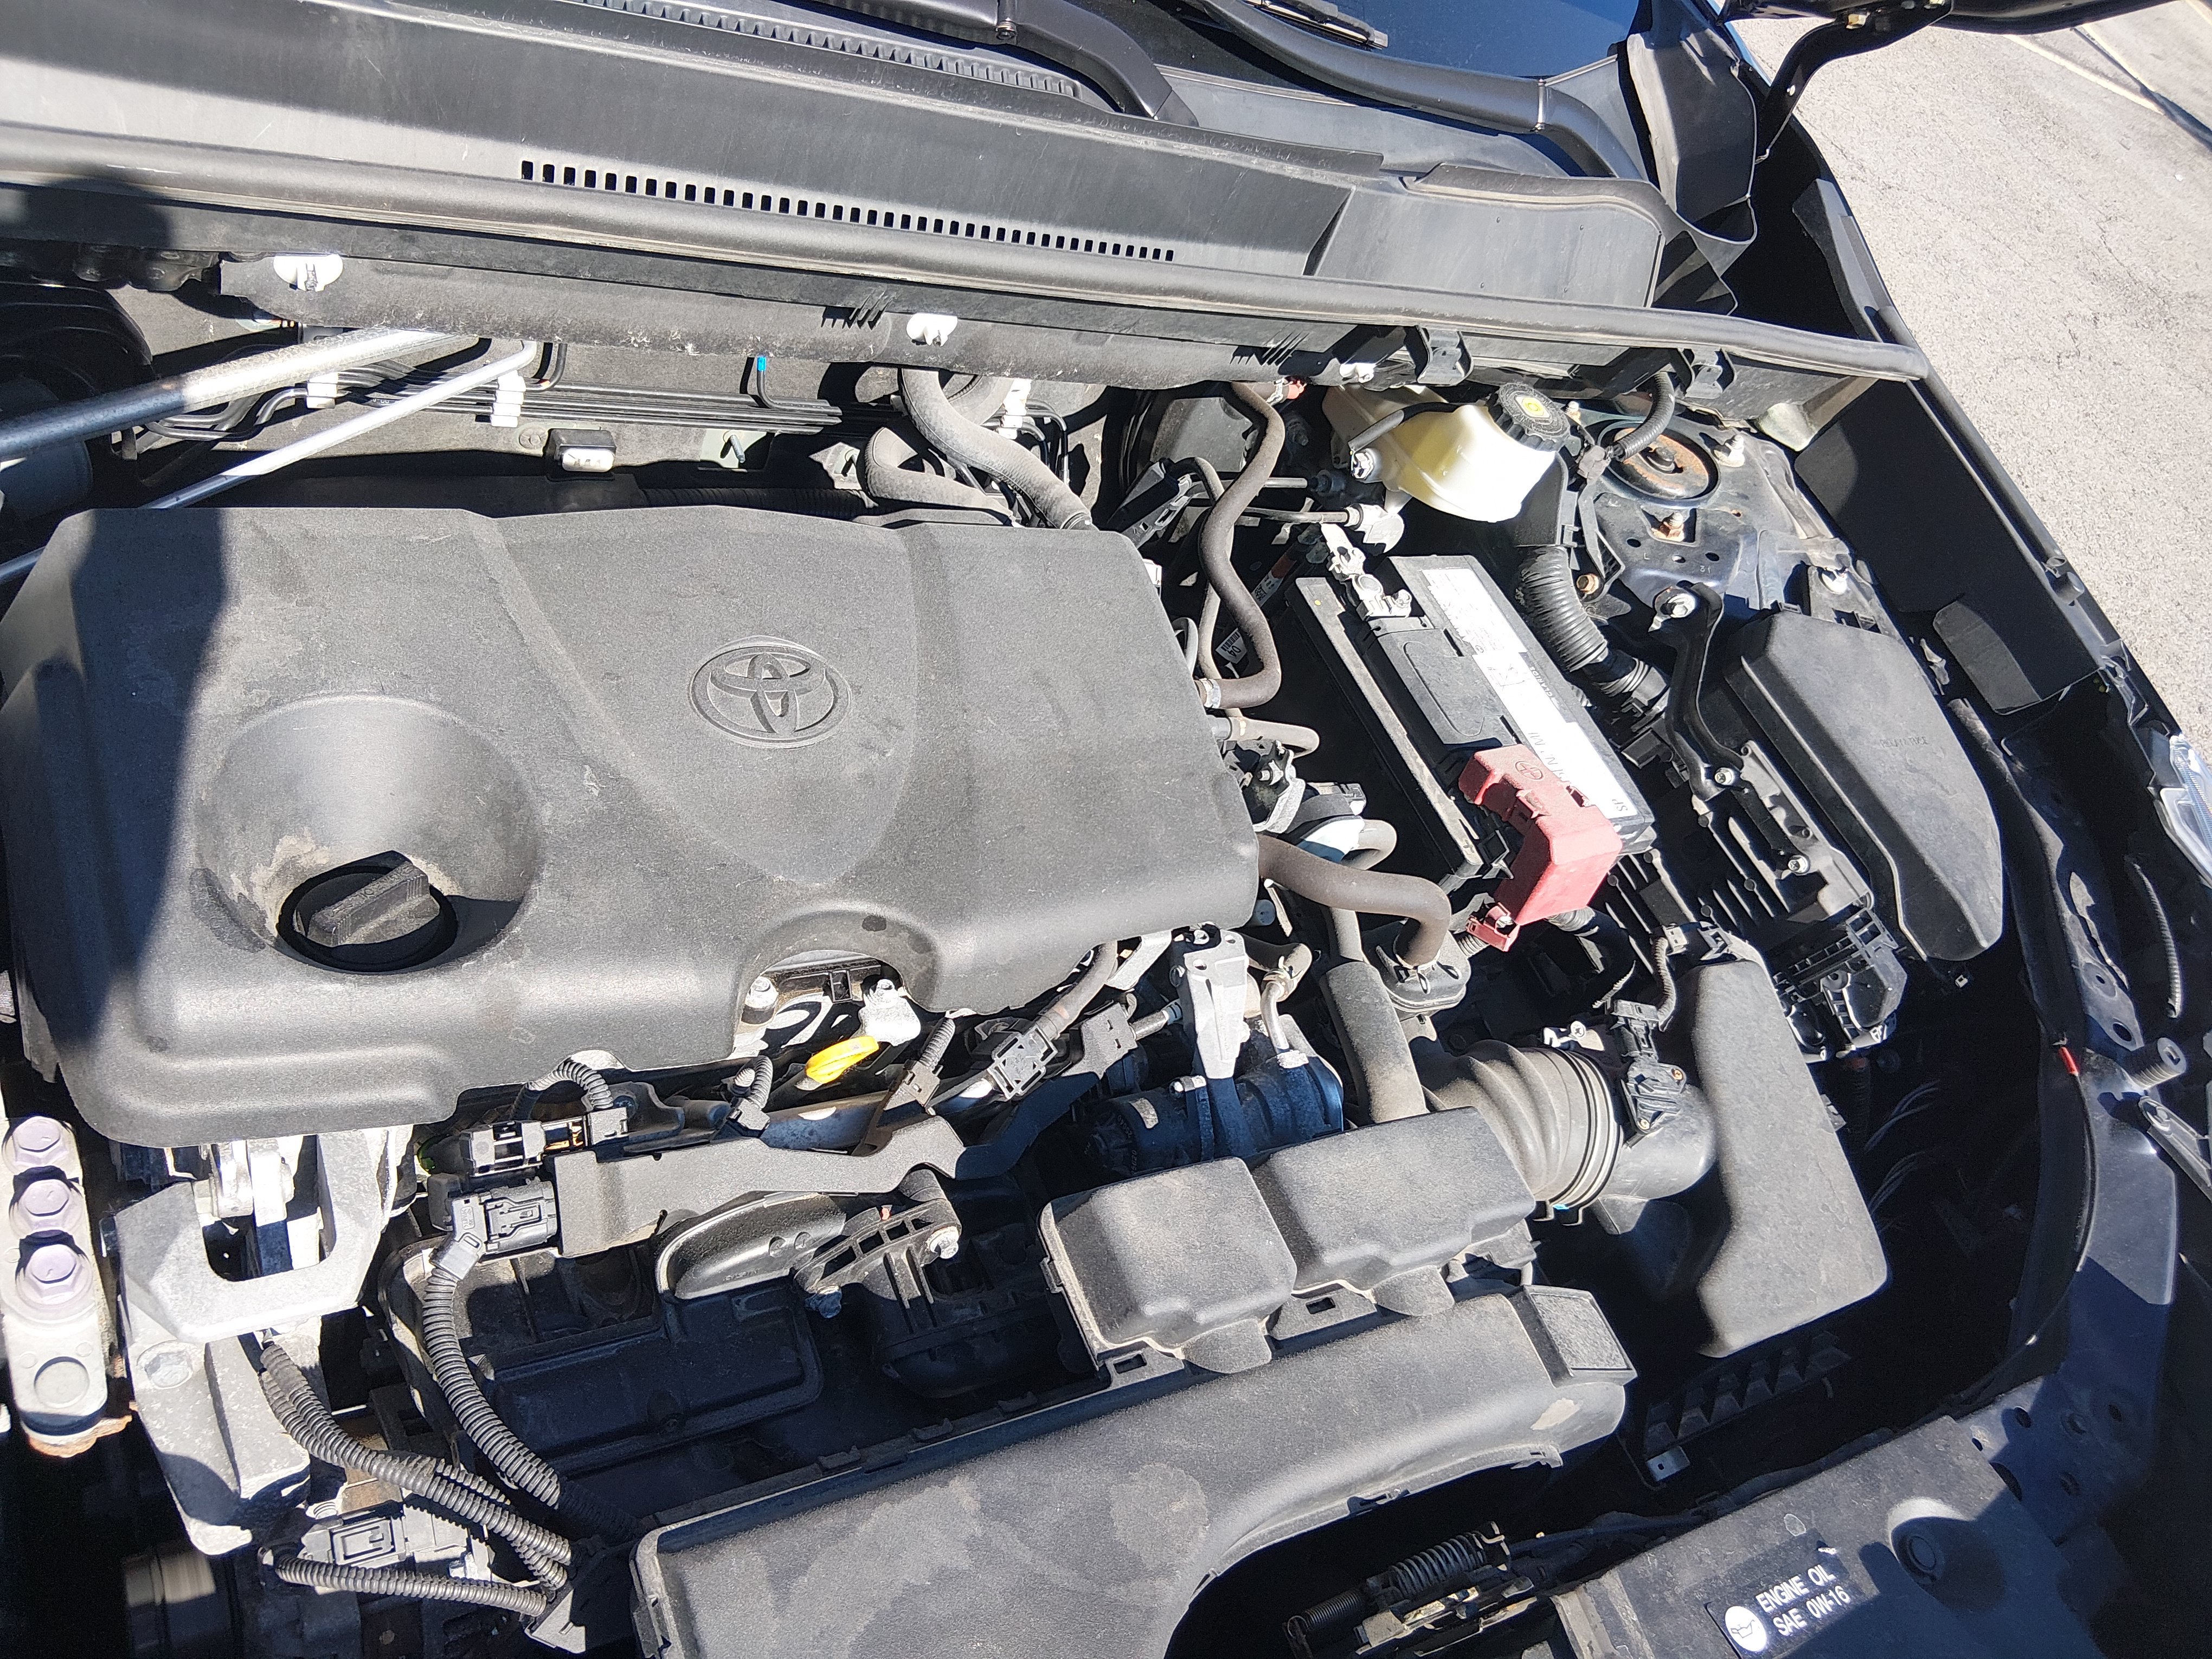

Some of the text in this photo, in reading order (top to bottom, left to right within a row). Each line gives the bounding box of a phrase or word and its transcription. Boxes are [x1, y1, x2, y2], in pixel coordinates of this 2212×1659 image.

[1529, 666, 1553, 697] CLARIOS
[1755, 1564, 1837, 1613] ENGINE OIL
[1772, 1585, 1851, 1636] SAE 0W-16
